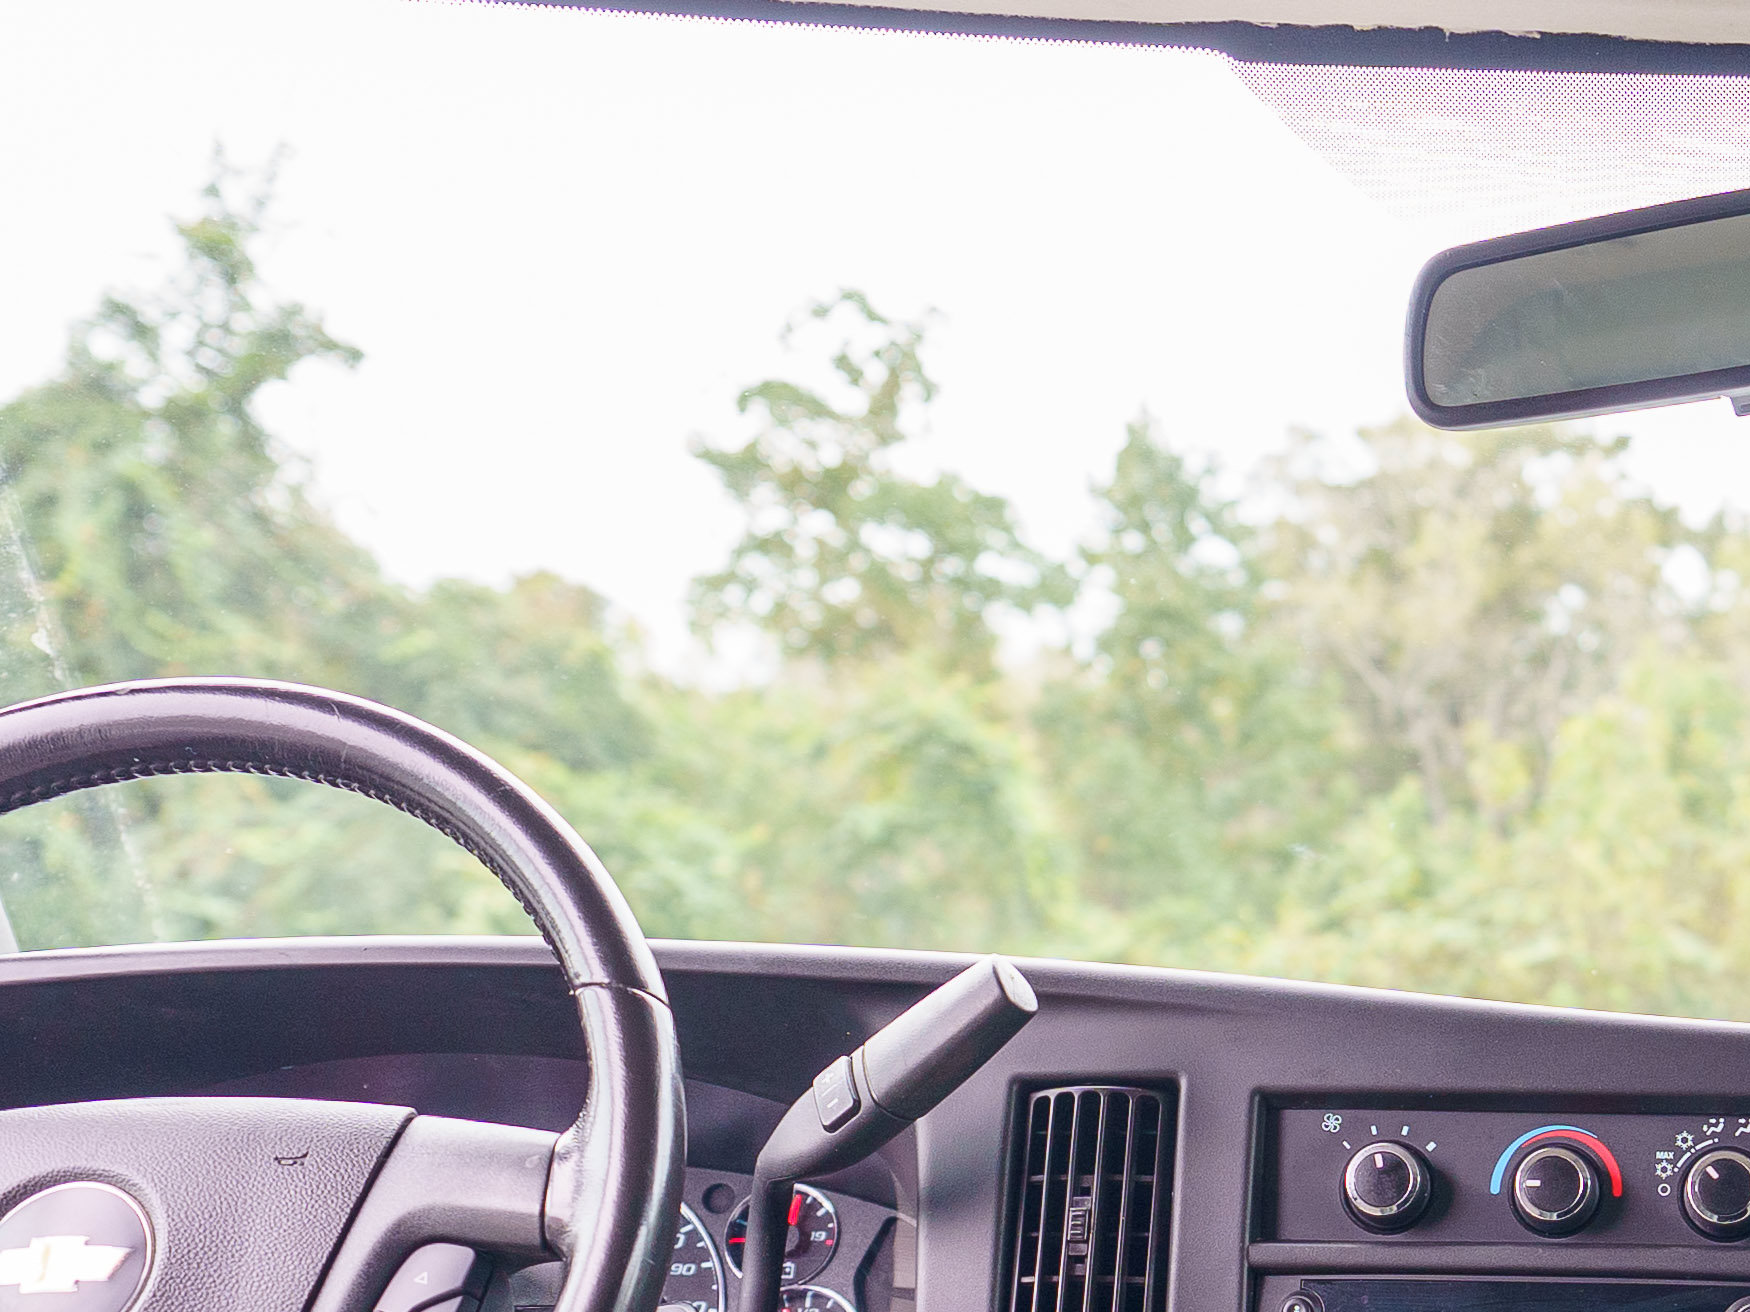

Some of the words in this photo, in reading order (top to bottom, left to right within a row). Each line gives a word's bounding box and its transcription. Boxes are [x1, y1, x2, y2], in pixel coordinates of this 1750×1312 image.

[1655, 1151, 1675, 1160] MAX
[810, 1231, 826, 1241] 19
[670, 1262, 696, 1276] 90
